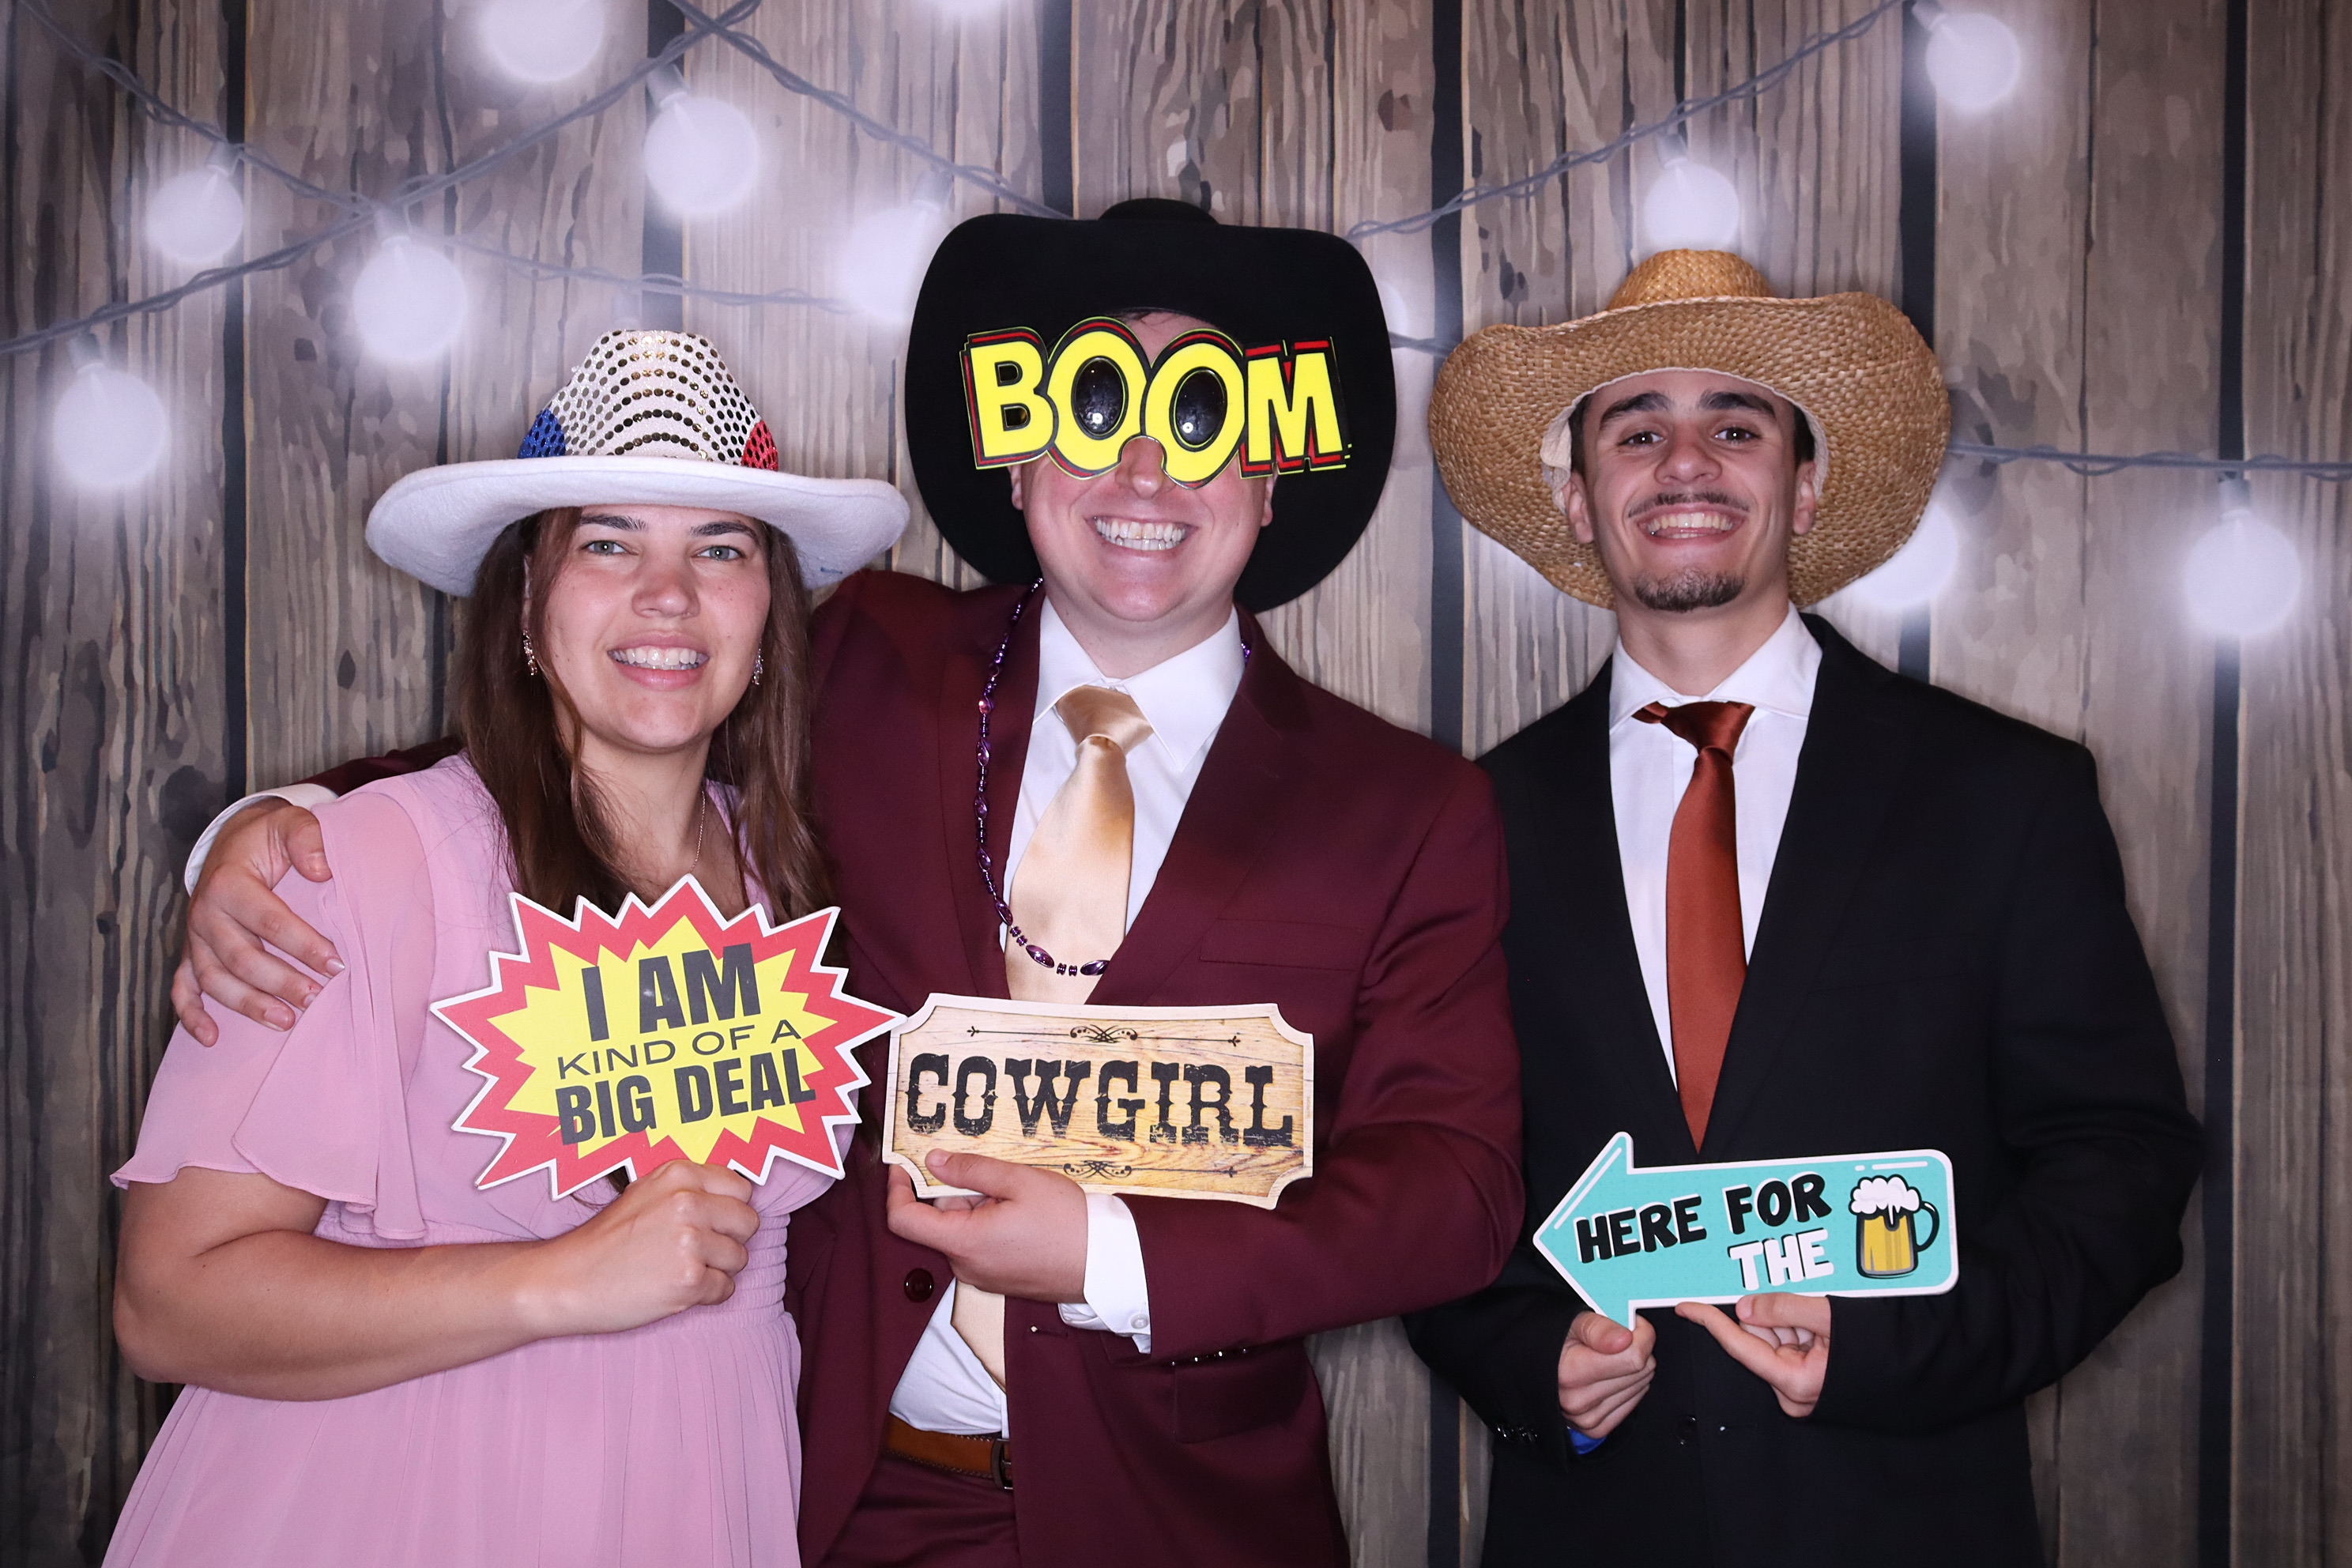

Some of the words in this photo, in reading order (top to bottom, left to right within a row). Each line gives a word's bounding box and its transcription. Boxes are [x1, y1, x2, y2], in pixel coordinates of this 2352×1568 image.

[962, 319, 1347, 487] BOOM
[581, 966, 610, 1042] I
[639, 943, 761, 1034] AM
[555, 1074, 658, 1146] BIG
[673, 1047, 816, 1125] DEAL
[557, 1039, 676, 1080] KIND
[692, 1024, 756, 1056] OF
[770, 1019, 802, 1044] A
[905, 1052, 1293, 1147] COWGIRL
[1574, 1193, 1707, 1264] HERE
[1722, 1170, 1833, 1235] FOR
[1728, 1227, 1835, 1291] THE
